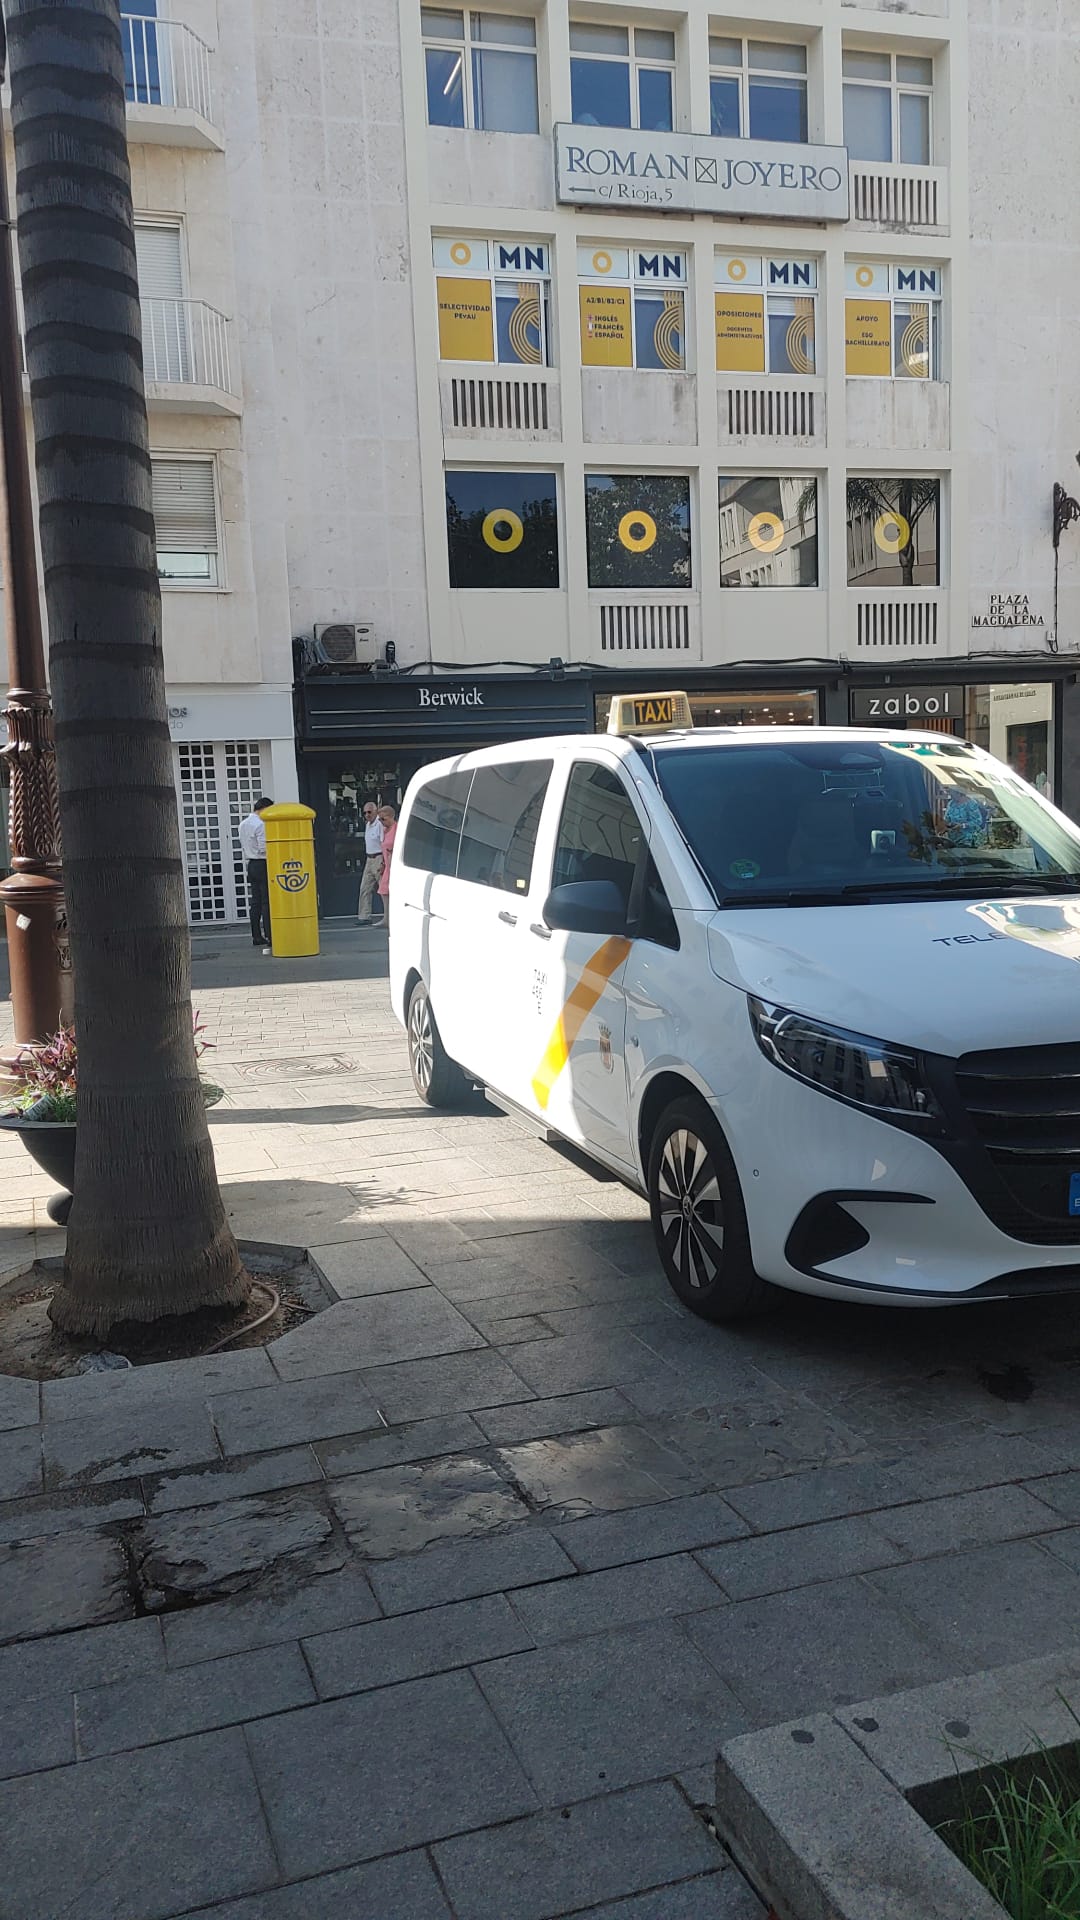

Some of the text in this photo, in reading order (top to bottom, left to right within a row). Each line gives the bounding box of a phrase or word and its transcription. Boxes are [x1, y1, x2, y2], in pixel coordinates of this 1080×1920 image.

[566, 146, 842, 192] ROMAN JOYERO
[439, 303, 491, 312] SELECTIVIDAD
[716, 310, 762, 318] OPOSICIONES
[594, 330, 624, 339] ESPAÑOL
[845, 339, 890, 347] BACHILLERATO
[990, 594, 1030, 605] PLAZA
[990, 604, 1030, 615] DE LA
[972, 615, 1045, 626] MAGDALENA
[418, 687, 485, 706] Berwick
[868, 692, 950, 715] zabol
[635, 700, 673, 723] TAXI
